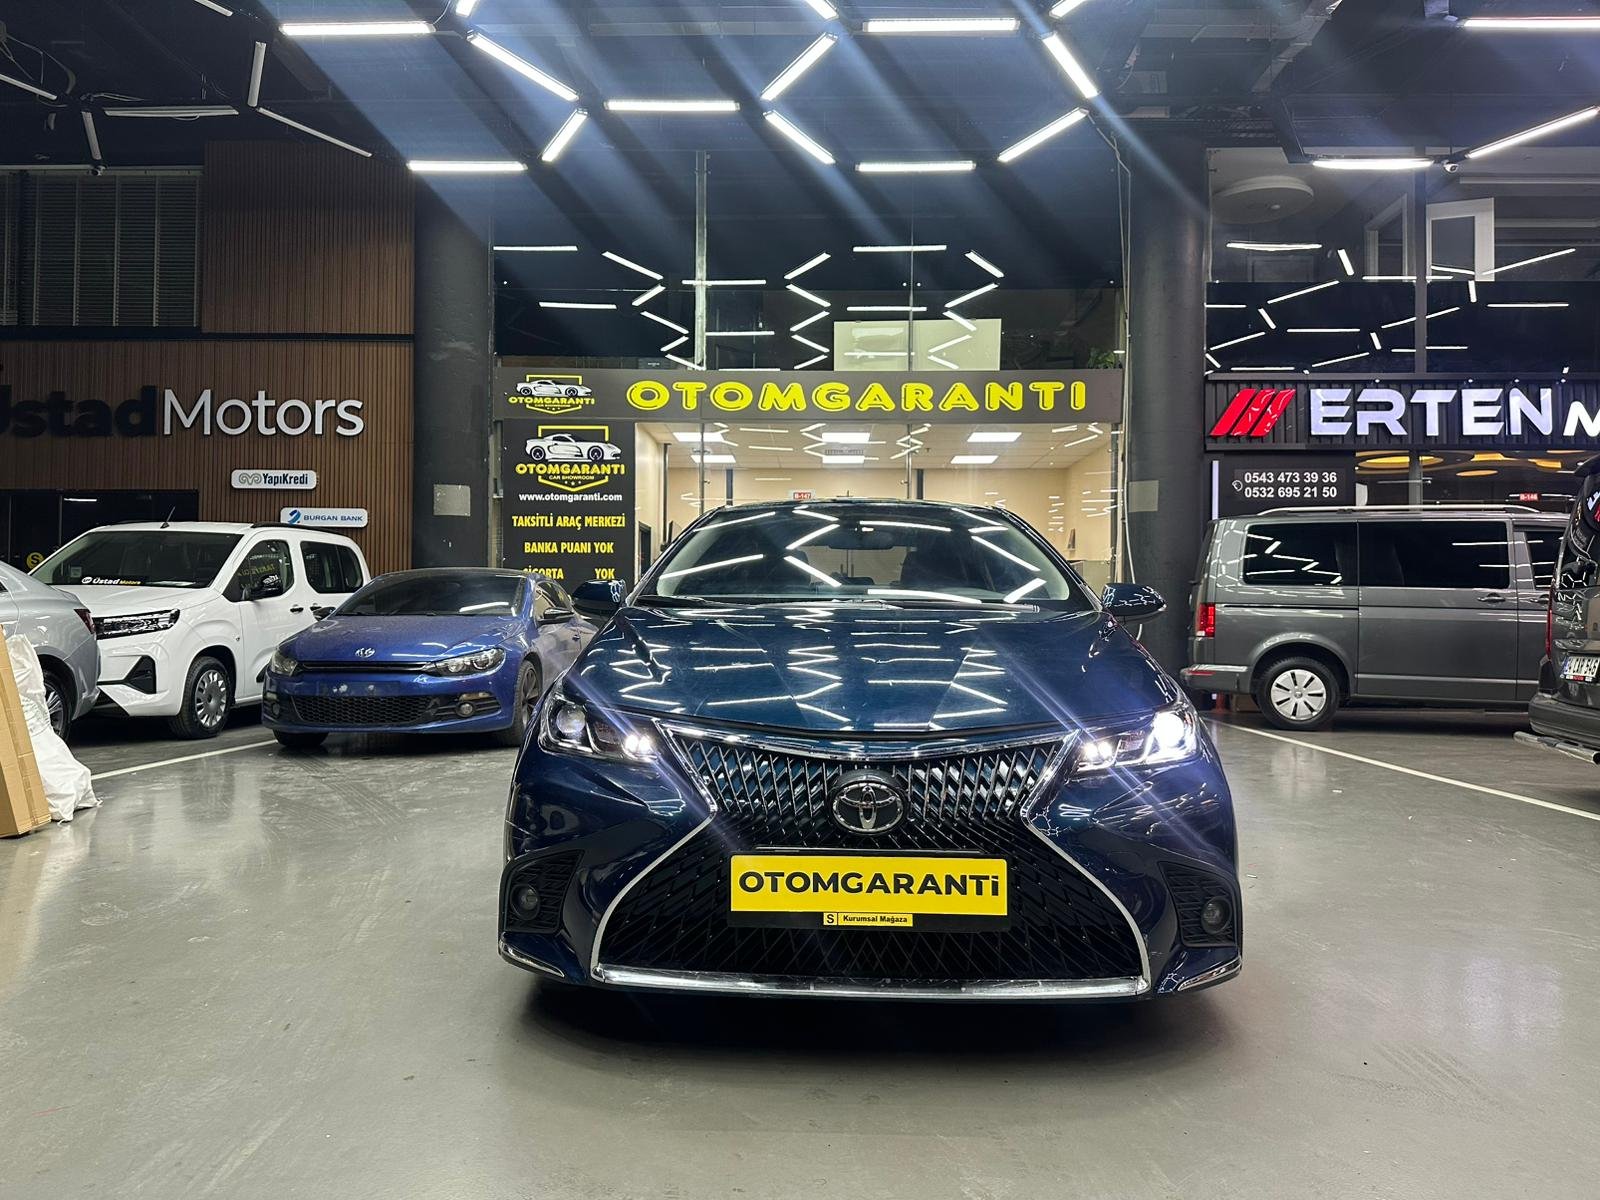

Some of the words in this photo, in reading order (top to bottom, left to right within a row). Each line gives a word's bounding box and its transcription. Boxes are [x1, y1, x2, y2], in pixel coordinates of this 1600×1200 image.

[508, 396, 595, 405] OTOMGARANTI
[626, 380, 1086, 412] OTOMGARANTI
[163, 388, 364, 437] Motors
[1310, 388, 1553, 436] ERTEN
[515, 463, 625, 475] OTOMGARANTI
[1244, 472, 1274, 483] 0543
[1277, 472, 1300, 483] 473
[1303, 472, 1319, 483] 39
[1322, 472, 1337, 483] 36
[519, 492, 622, 503] www.otomgaranti.com
[1244, 486, 1274, 498] 0532
[1277, 486, 1300, 498] 695
[1303, 486, 1318, 498] 21
[1322, 486, 1337, 498] 50
[512, 513, 554, 527] TAKSİTLİ
[556, 515, 582, 530] ARAÇ
[584, 513, 625, 527] MERKEZİ
[524, 542, 558, 553] BANKA
[561, 542, 591, 553] PUANI
[594, 542, 614, 553] YOK
[595, 568, 615, 579] YOK
[880, 915, 908, 924] Mağaza
